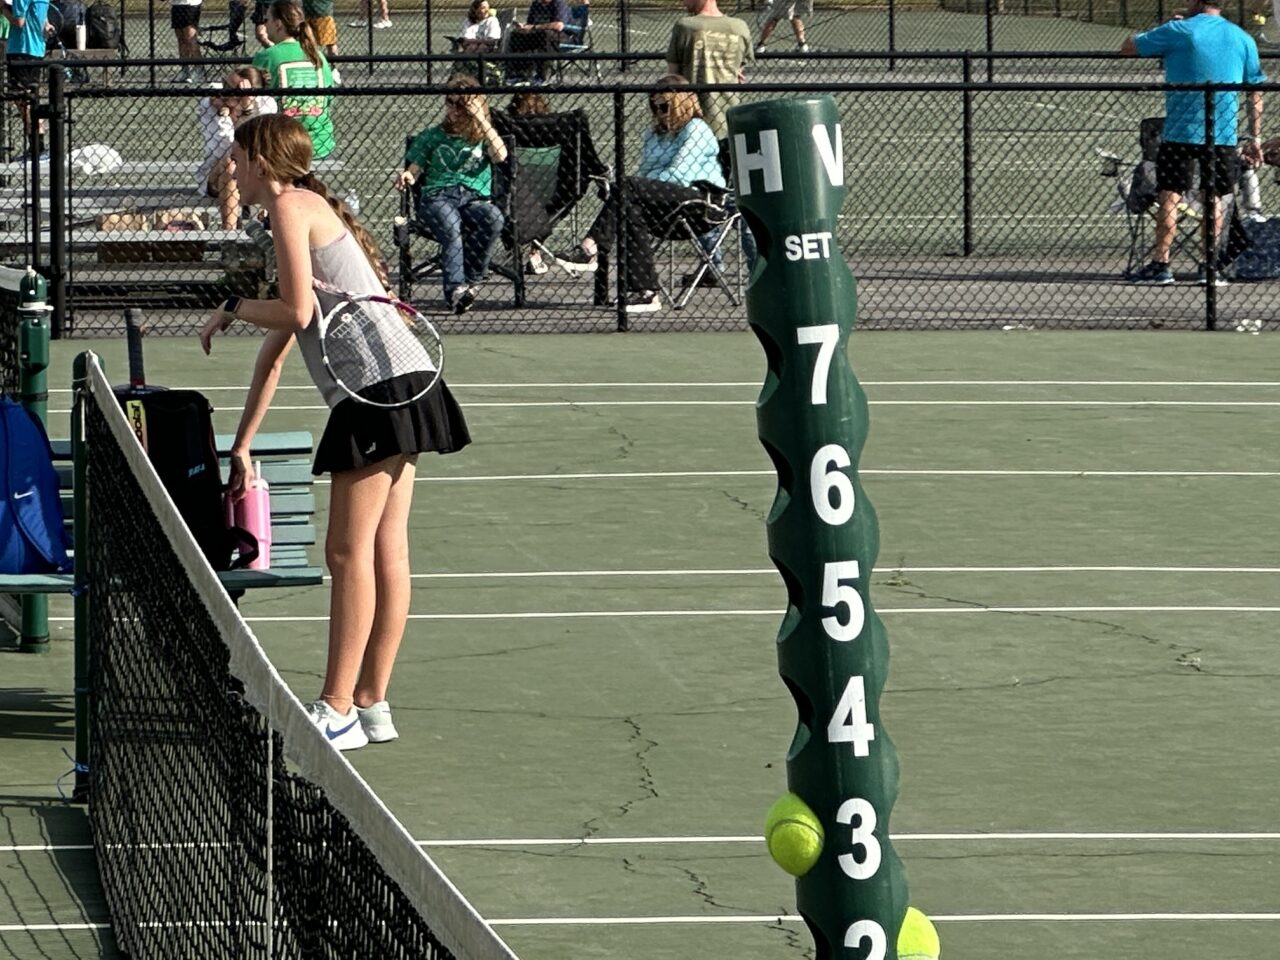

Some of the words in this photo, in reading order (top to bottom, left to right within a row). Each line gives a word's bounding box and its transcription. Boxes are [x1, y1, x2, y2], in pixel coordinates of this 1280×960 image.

[734, 128, 784, 196] H
[811, 123, 844, 187] V
[784, 231, 833, 261] SET
[796, 324, 840, 405] 7
[810, 443, 855, 526] 6
[821, 559, 865, 642] 5
[827, 675, 875, 757] 4
[836, 797, 882, 880] 3
